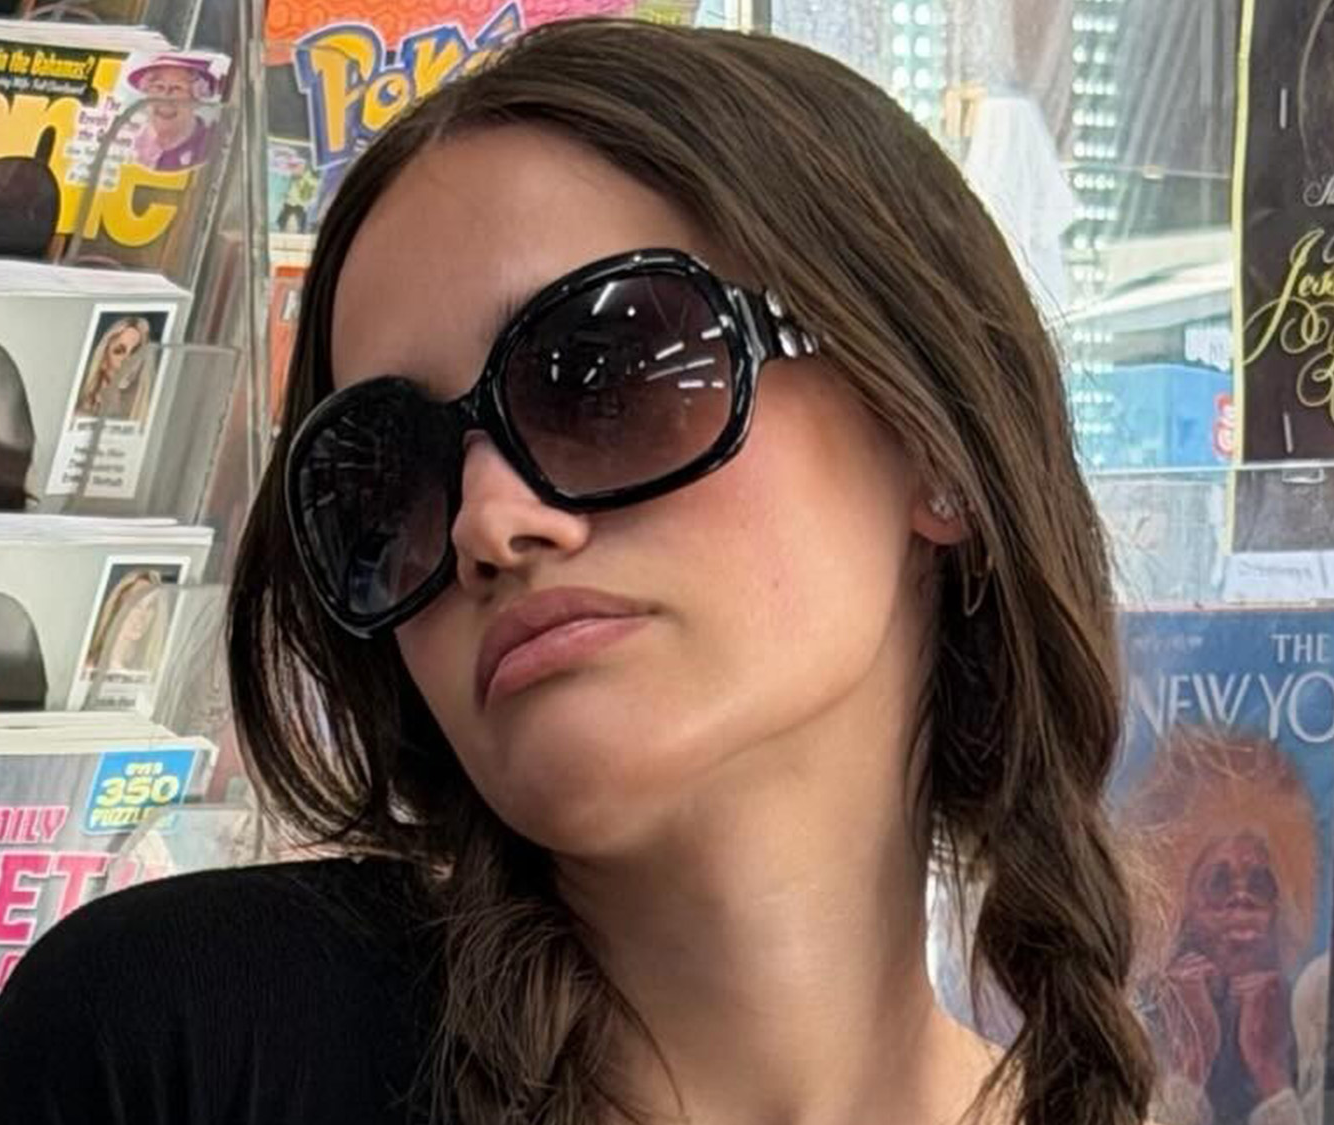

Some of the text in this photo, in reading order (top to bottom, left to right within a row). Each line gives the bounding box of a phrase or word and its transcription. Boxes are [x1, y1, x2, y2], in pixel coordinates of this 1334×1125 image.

[9, 48, 32, 73] the
[1270, 633, 1332, 664] THE
[96, 776, 179, 807] 350
